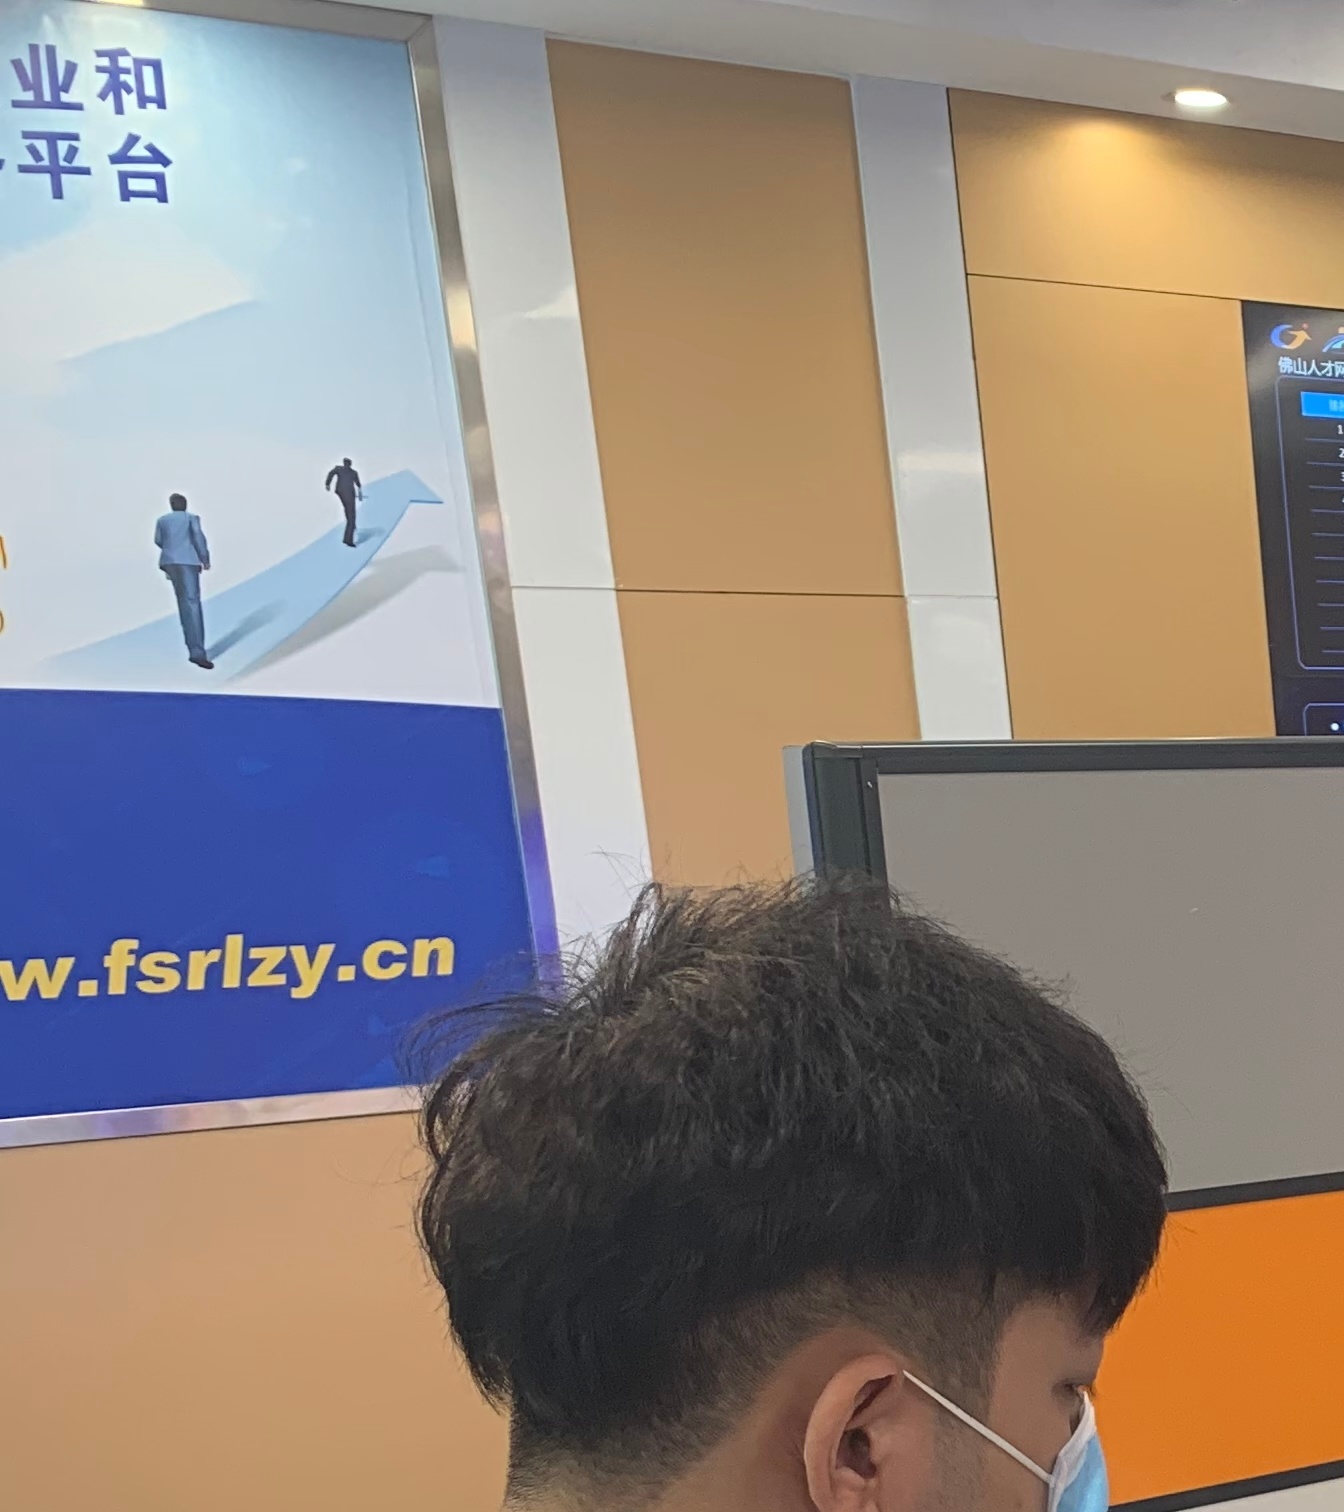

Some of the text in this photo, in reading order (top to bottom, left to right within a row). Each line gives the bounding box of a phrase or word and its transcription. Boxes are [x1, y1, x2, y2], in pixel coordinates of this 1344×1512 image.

[10, 43, 167, 116] 业和
[0, 132, 173, 203] 平台
[1337, 424, 1344, 435] 1
